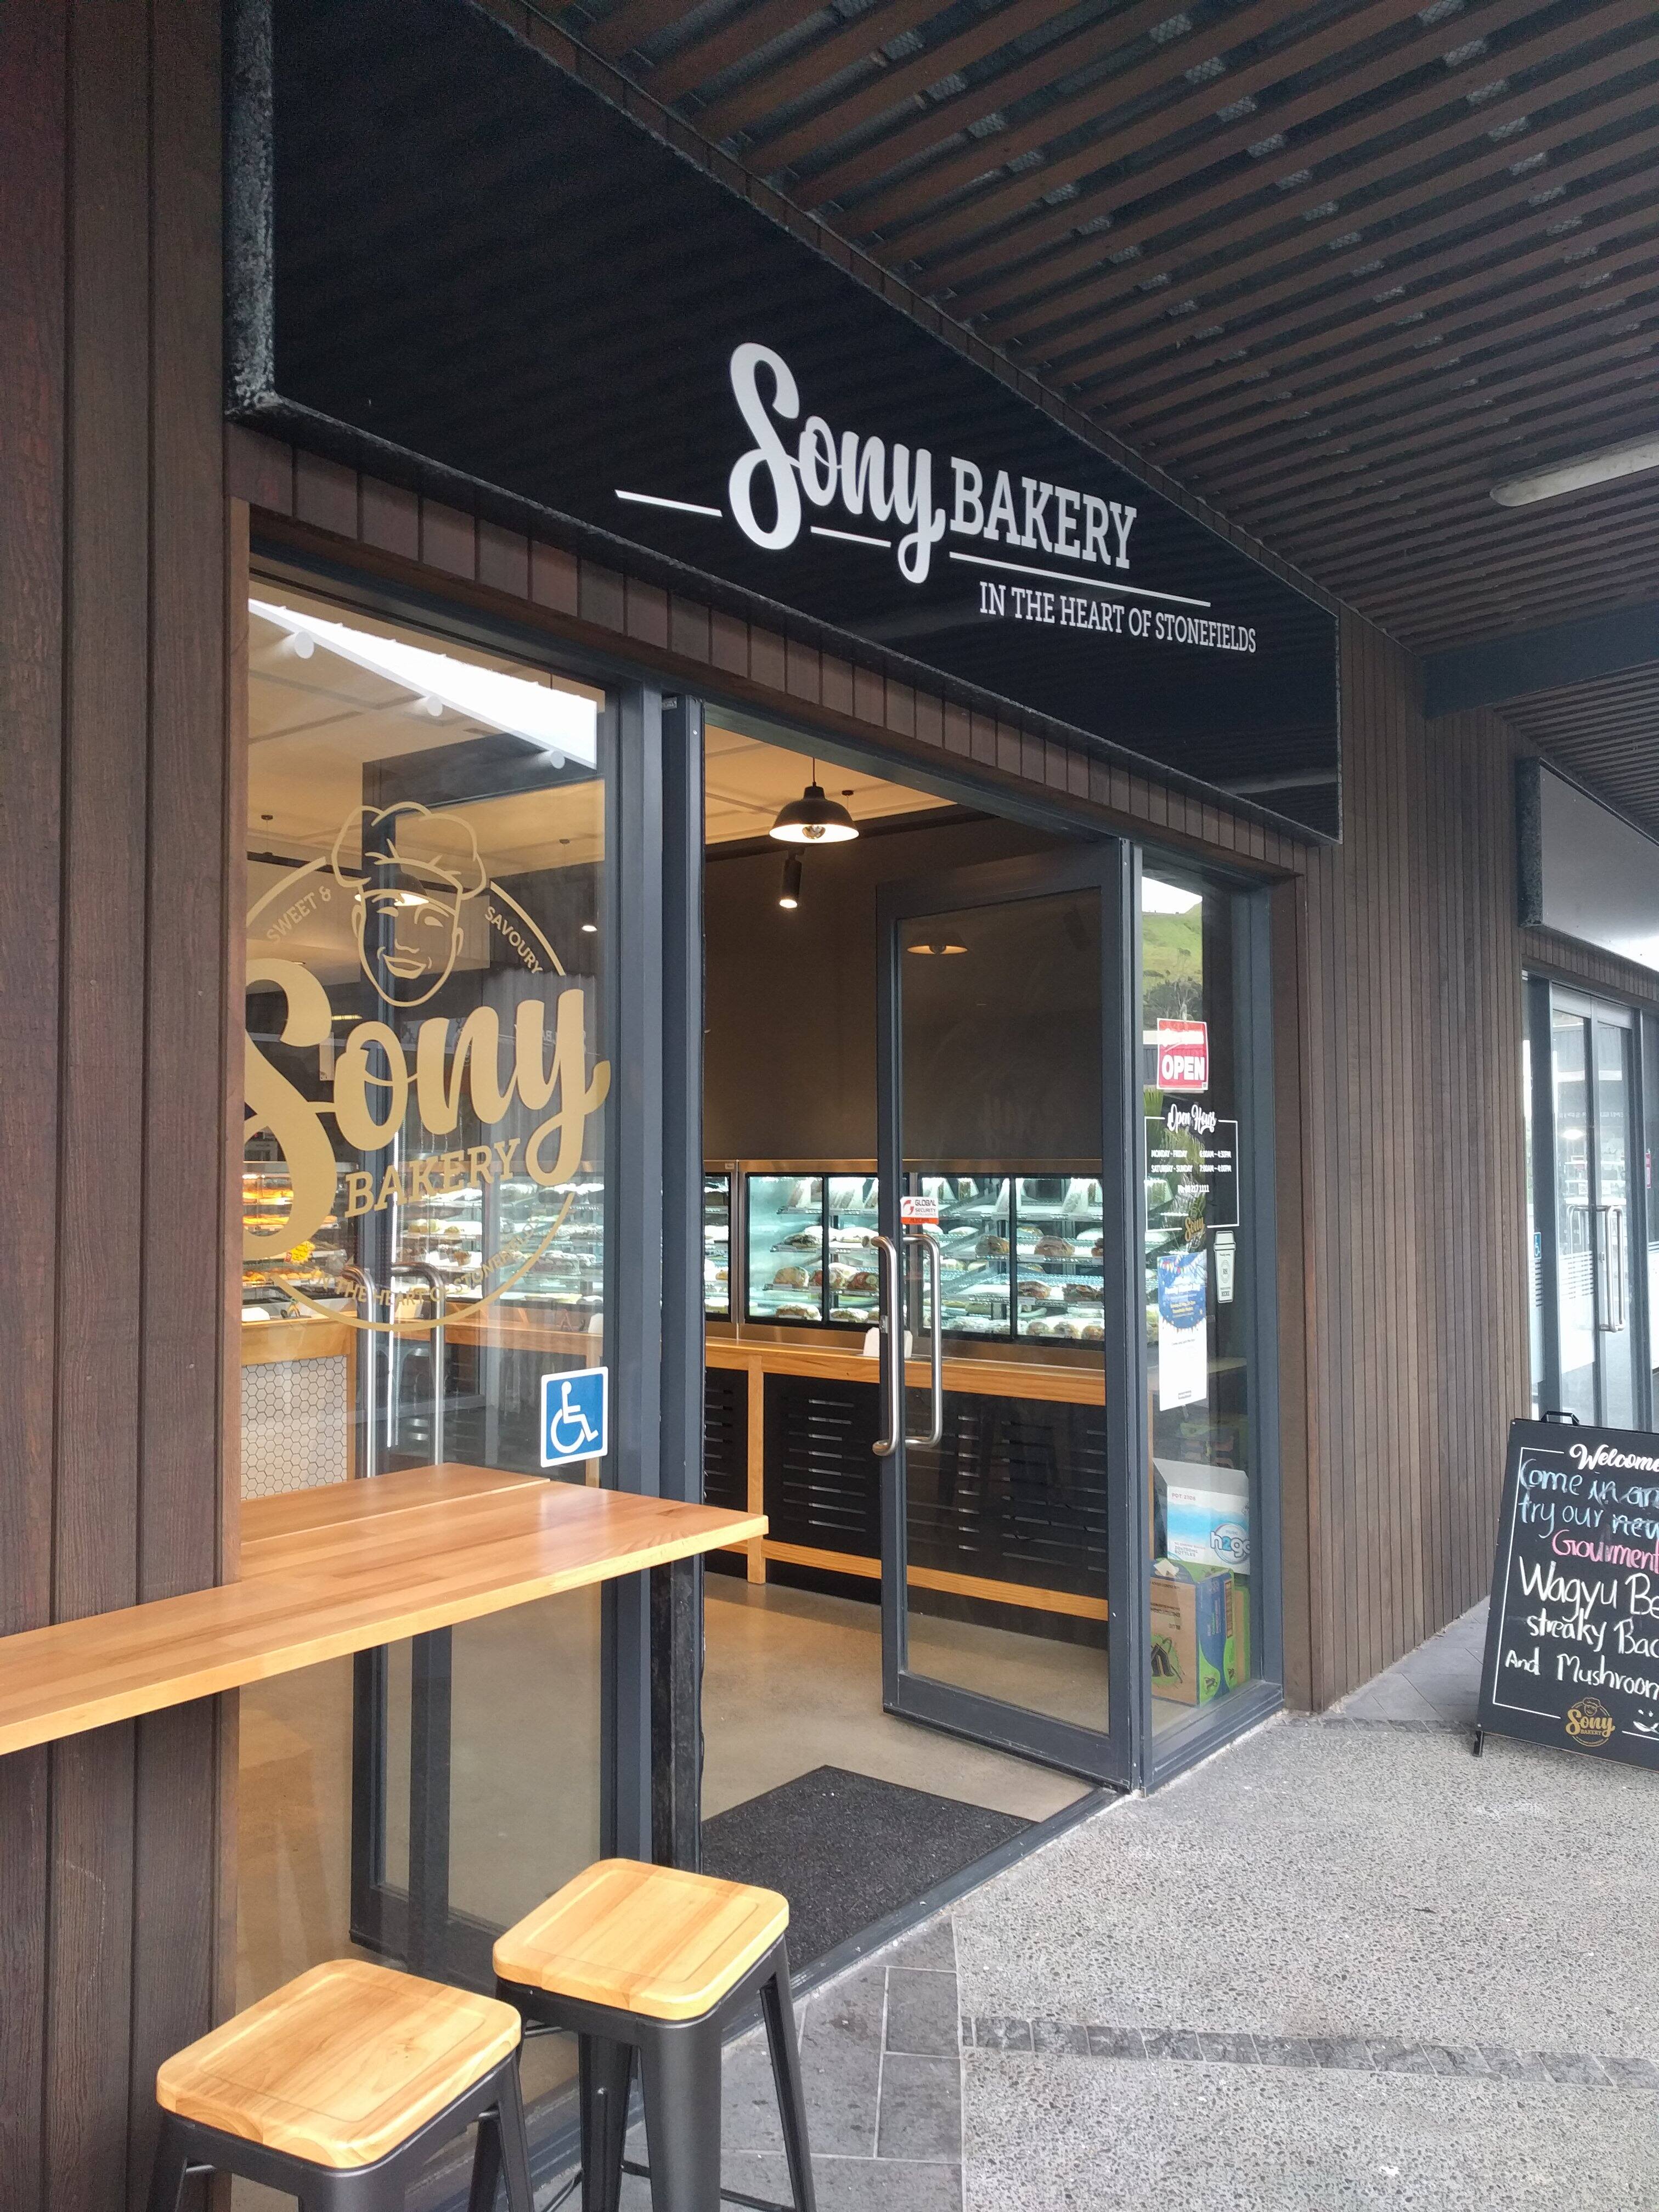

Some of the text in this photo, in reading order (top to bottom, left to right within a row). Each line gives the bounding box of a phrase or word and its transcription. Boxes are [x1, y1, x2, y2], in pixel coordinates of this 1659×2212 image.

[729, 342, 1137, 584] Sony BAKERY
[979, 580, 1256, 653] IN THE HEART OF STONEFIELDS
[266, 894, 319, 943] SWEET
[484, 906, 543, 974] SAVOURY
[1161, 1054, 1205, 1081] OPEN
[242, 958, 611, 1260] Sony
[1167, 1103, 1192, 1133] Open
[344, 1138, 521, 1218] BAKERY
[1519, 1458, 1583, 1496] Come
[1587, 1471, 1620, 1505] in
[1518, 1492, 1555, 1539] try
[1562, 1505, 1604, 1528] our
[1519, 1556, 1618, 1622] Wagyu
[1505, 1646, 1541, 1675] And
[1565, 1708, 1616, 1737] Sony
